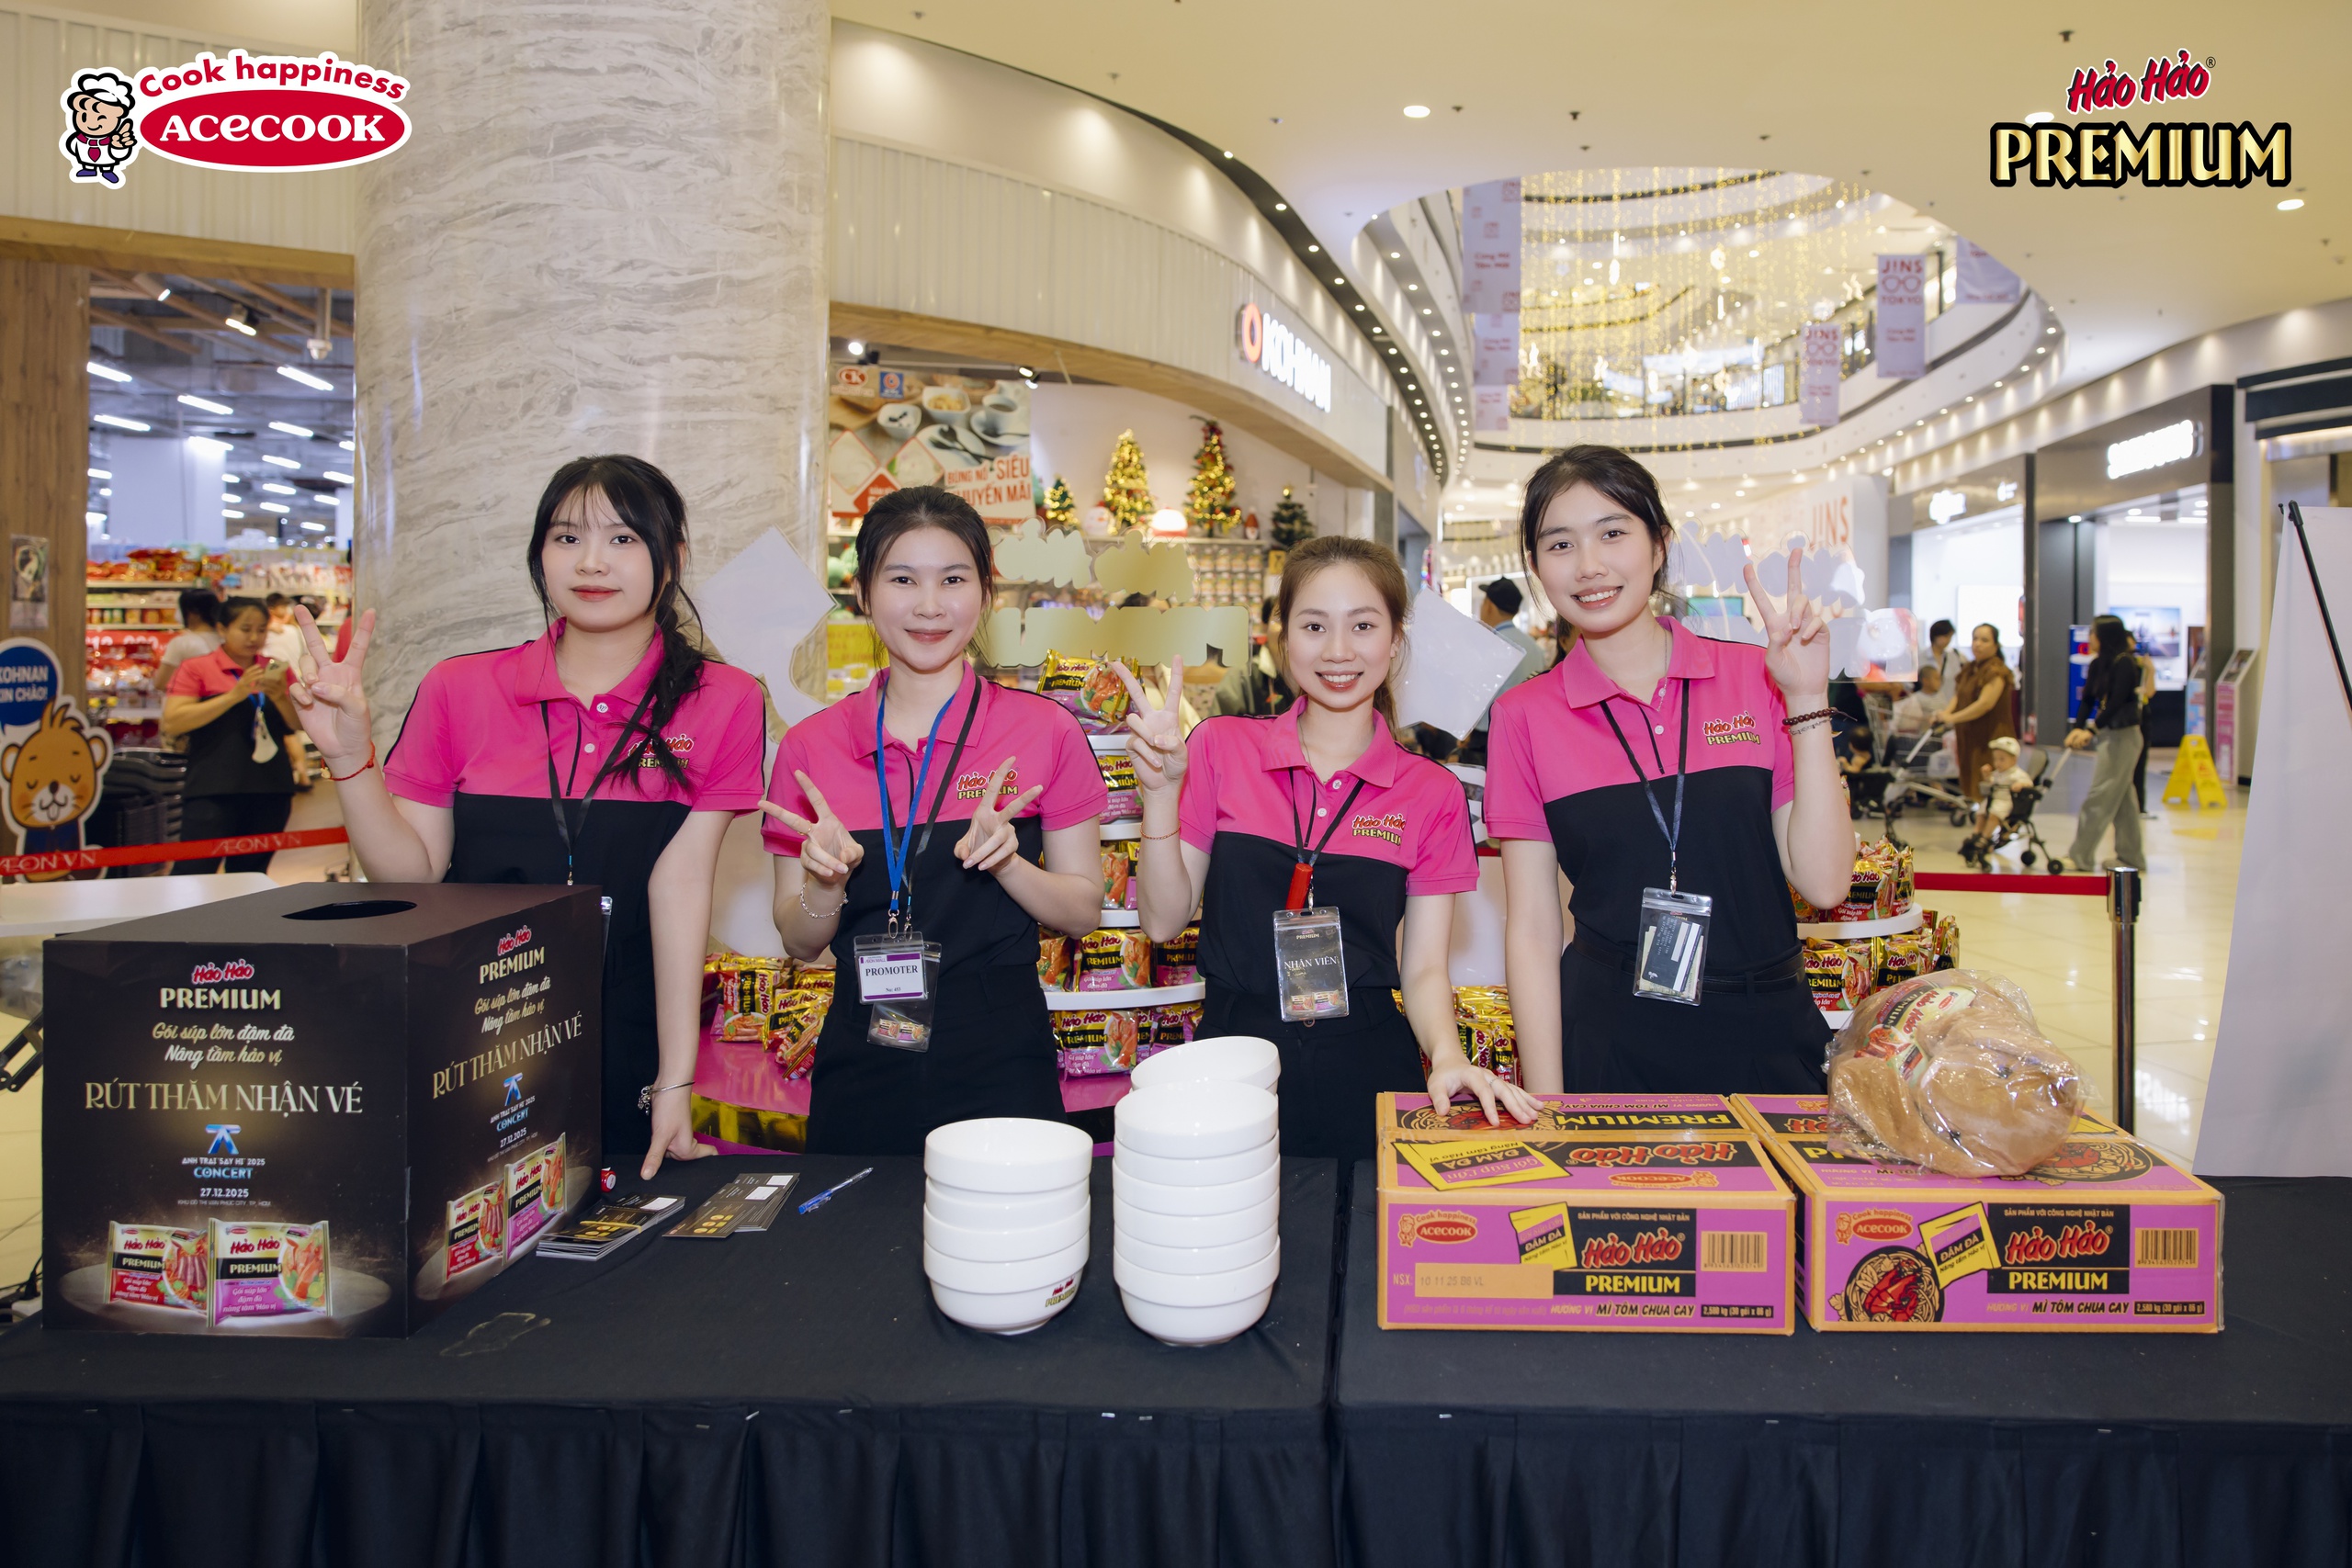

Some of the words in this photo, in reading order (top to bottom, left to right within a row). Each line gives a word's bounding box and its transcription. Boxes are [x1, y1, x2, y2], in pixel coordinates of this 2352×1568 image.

[1882, 259, 1923, 274] JINS
[996, 456, 1030, 480] SIÊU
[1809, 495, 1849, 552] JINS
[957, 771, 988, 791] Hảo
[1352, 814, 1382, 829] Hảo
[1352, 828, 1402, 846] PREMIU
[497, 932, 514, 956] Hảo
[514, 925, 533, 948] Hảo
[192, 963, 222, 985] Hảo
[223, 959, 254, 982] Hảo
[479, 946, 545, 985] PREMIUM
[865, 964, 918, 976] PROMOTER
[160, 987, 281, 1010] PREMIUM
[474, 998, 490, 1015] Gói
[491, 993, 506, 1011] súp
[506, 987, 521, 1004] lớn
[522, 982, 539, 999] đậm
[540, 976, 551, 991] đà
[481, 1014, 504, 1035] Nâng
[504, 1008, 522, 1024] tầm
[522, 1002, 536, 1020] hảo
[537, 998, 545, 1014] vị
[1082, 1010, 1107, 1025] Hảo
[152, 1022, 179, 1040] Gói
[180, 1024, 208, 1043] súp
[209, 1022, 236, 1041] lớn
[237, 1023, 271, 1043] đậm
[273, 1023, 296, 1041] đà
[164, 1044, 205, 1070] Nâng
[206, 1044, 236, 1062] tầm
[237, 1044, 266, 1064] hảo
[268, 1048, 283, 1066] vị
[433, 1060, 469, 1099] RÚT
[469, 1041, 516, 1082] THĂM
[520, 1022, 562, 1060] NHẬN
[564, 1010, 582, 1040] VÉ
[85, 1077, 141, 1110] RÚT
[145, 1079, 228, 1111] THĂM
[235, 1080, 320, 1118] NHẬN
[325, 1081, 363, 1113] VÉ
[496, 1107, 529, 1132] CONCERT
[1555, 1114, 1731, 1125] PREMIUM
[500, 1127, 527, 1148] 27.12.2025
[247, 1157, 266, 1166] 2025
[1569, 1146, 1654, 1168] Hảo
[1655, 1142, 1737, 1166] Hảo
[193, 1167, 254, 1179] CONCERT
[200, 1188, 250, 1198] 27.12.2025
[515, 1182, 543, 1208] PREMIUM
[1416, 1213, 1435, 1223] Cook
[1437, 1209, 1476, 1224] happiness
[1852, 1210, 1871, 1222] Cook
[1872, 1209, 1913, 1223] happiness
[124, 1238, 143, 1250] Hảo
[145, 1237, 165, 1250] Hảo
[230, 1238, 254, 1254] Hảo
[257, 1235, 281, 1251] Hảo
[1583, 1232, 1632, 1269] Hảo
[1632, 1227, 1682, 1263] Hảo
[1940, 1244, 1963, 1262] ĐẬM
[1964, 1234, 1979, 1250] ĐÀ
[2005, 1228, 2056, 1265] Hảo
[2058, 1220, 2109, 1258] Hảo
[122, 1258, 165, 1269] PREMIUM
[230, 1263, 283, 1274] PREMIUM
[1434, 1277, 1444, 1286] 11
[1447, 1277, 1458, 1286] 25
[1585, 1275, 1680, 1294] PREMIUM
[2008, 1271, 2109, 1291] PREMIUM
[1596, 1303, 1612, 1316] MÌ
[1614, 1303, 1640, 1317] TÔM
[1642, 1304, 1672, 1317] CHUA
[1673, 1305, 1695, 1317] CAY
[2032, 1298, 2048, 1313] MÌ
[2050, 1299, 2074, 1314] TÔM
[2077, 1302, 2106, 1314] CHUA
[2109, 1302, 2130, 1314] CAY
